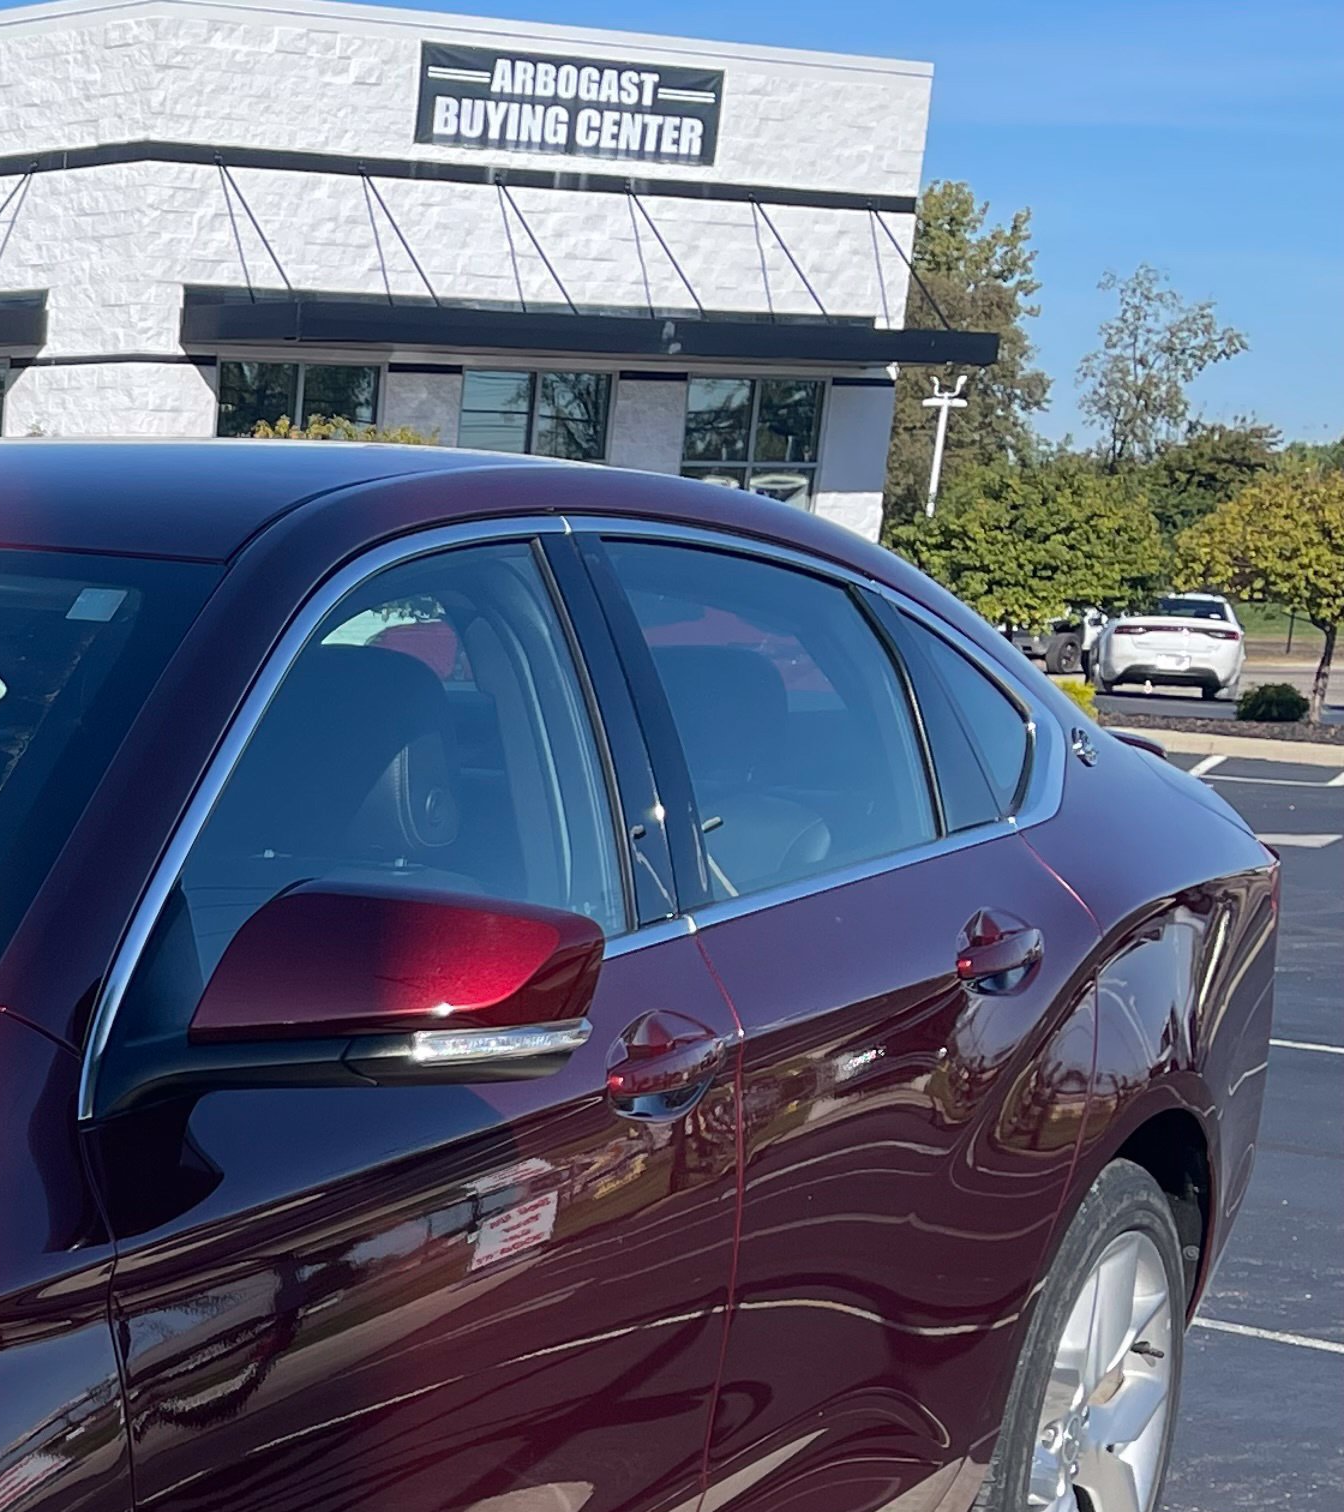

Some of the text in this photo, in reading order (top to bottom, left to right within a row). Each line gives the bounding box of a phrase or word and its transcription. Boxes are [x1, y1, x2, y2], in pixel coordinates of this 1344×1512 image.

[490, 58, 660, 107] ARBOGAST
[432, 95, 704, 156] BUYING CENTER
